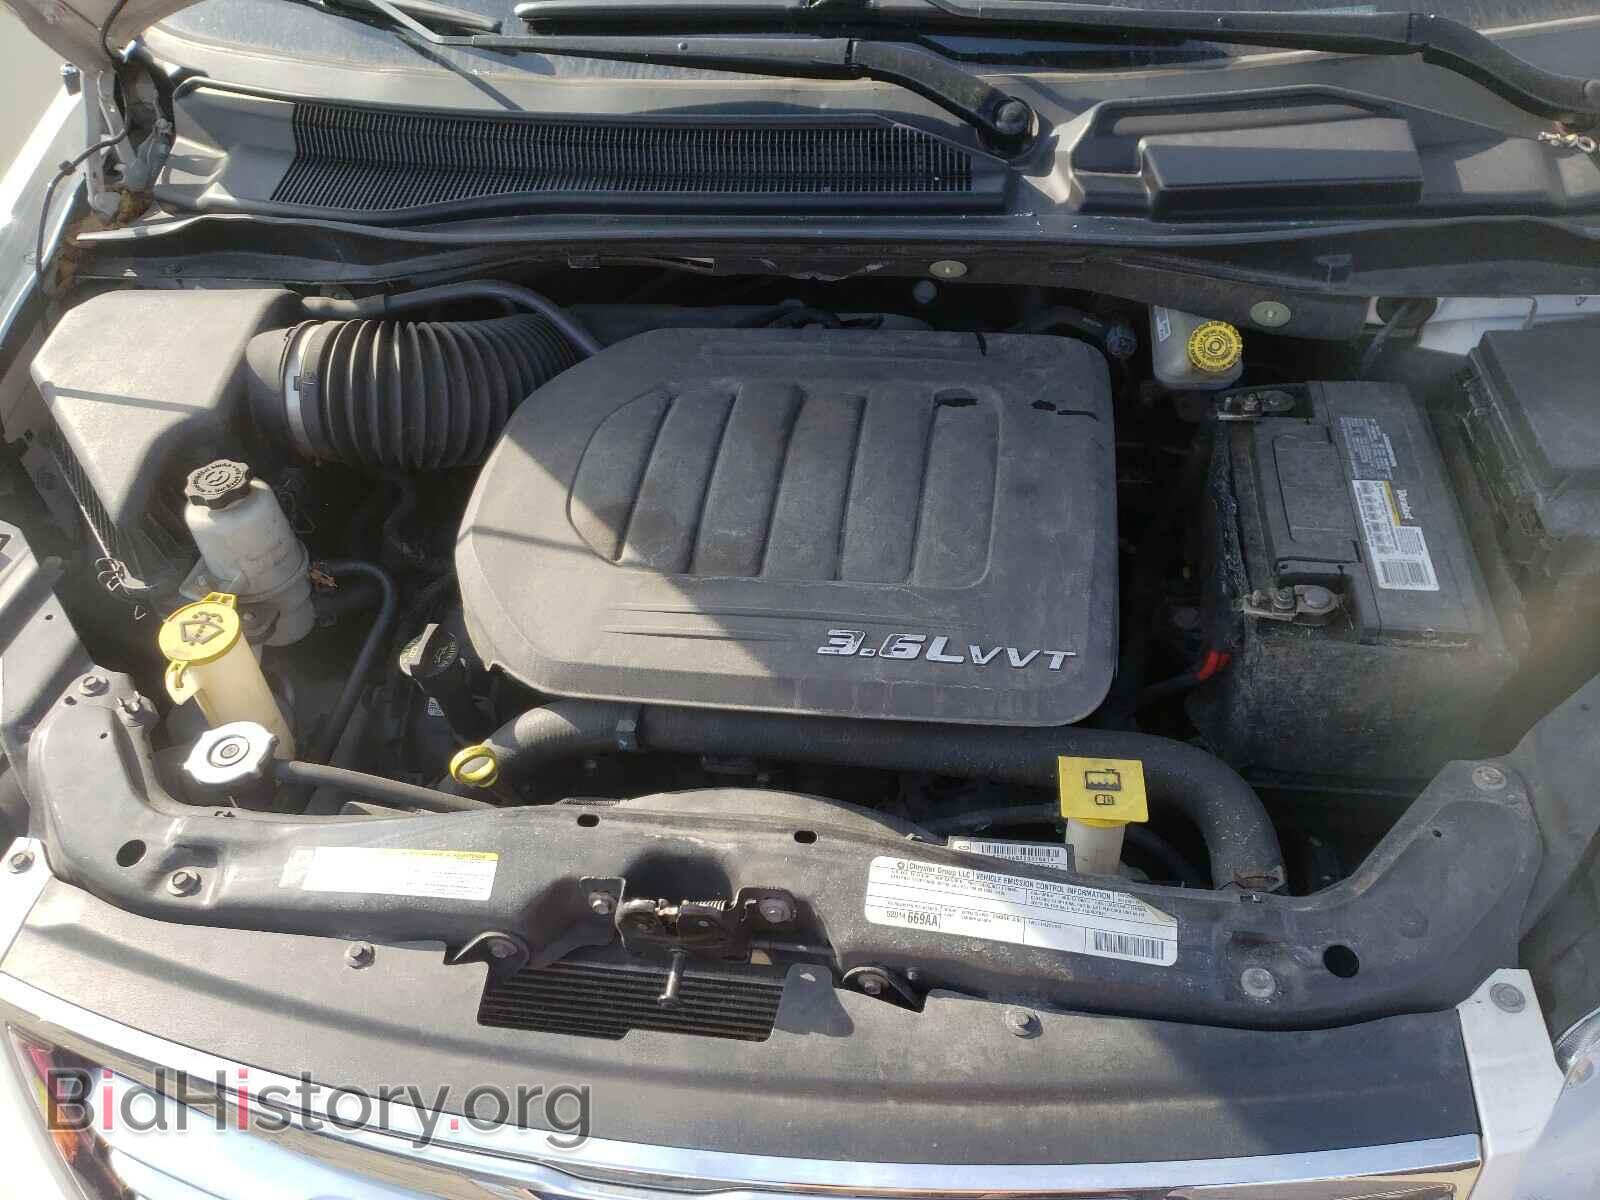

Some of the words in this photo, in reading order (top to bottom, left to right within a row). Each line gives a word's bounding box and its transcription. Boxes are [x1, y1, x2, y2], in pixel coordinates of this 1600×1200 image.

[909, 862, 935, 873] Chrysler
[937, 866, 957, 877] Group
[958, 869, 971, 879] LLC
[976, 871, 1001, 883] VEHICLE
[1003, 875, 1034, 889] EMISSION
[1036, 880, 1065, 894] CONTROL
[1067, 885, 1111, 901] INFORMATION
[908, 911, 938, 926] 669AA
